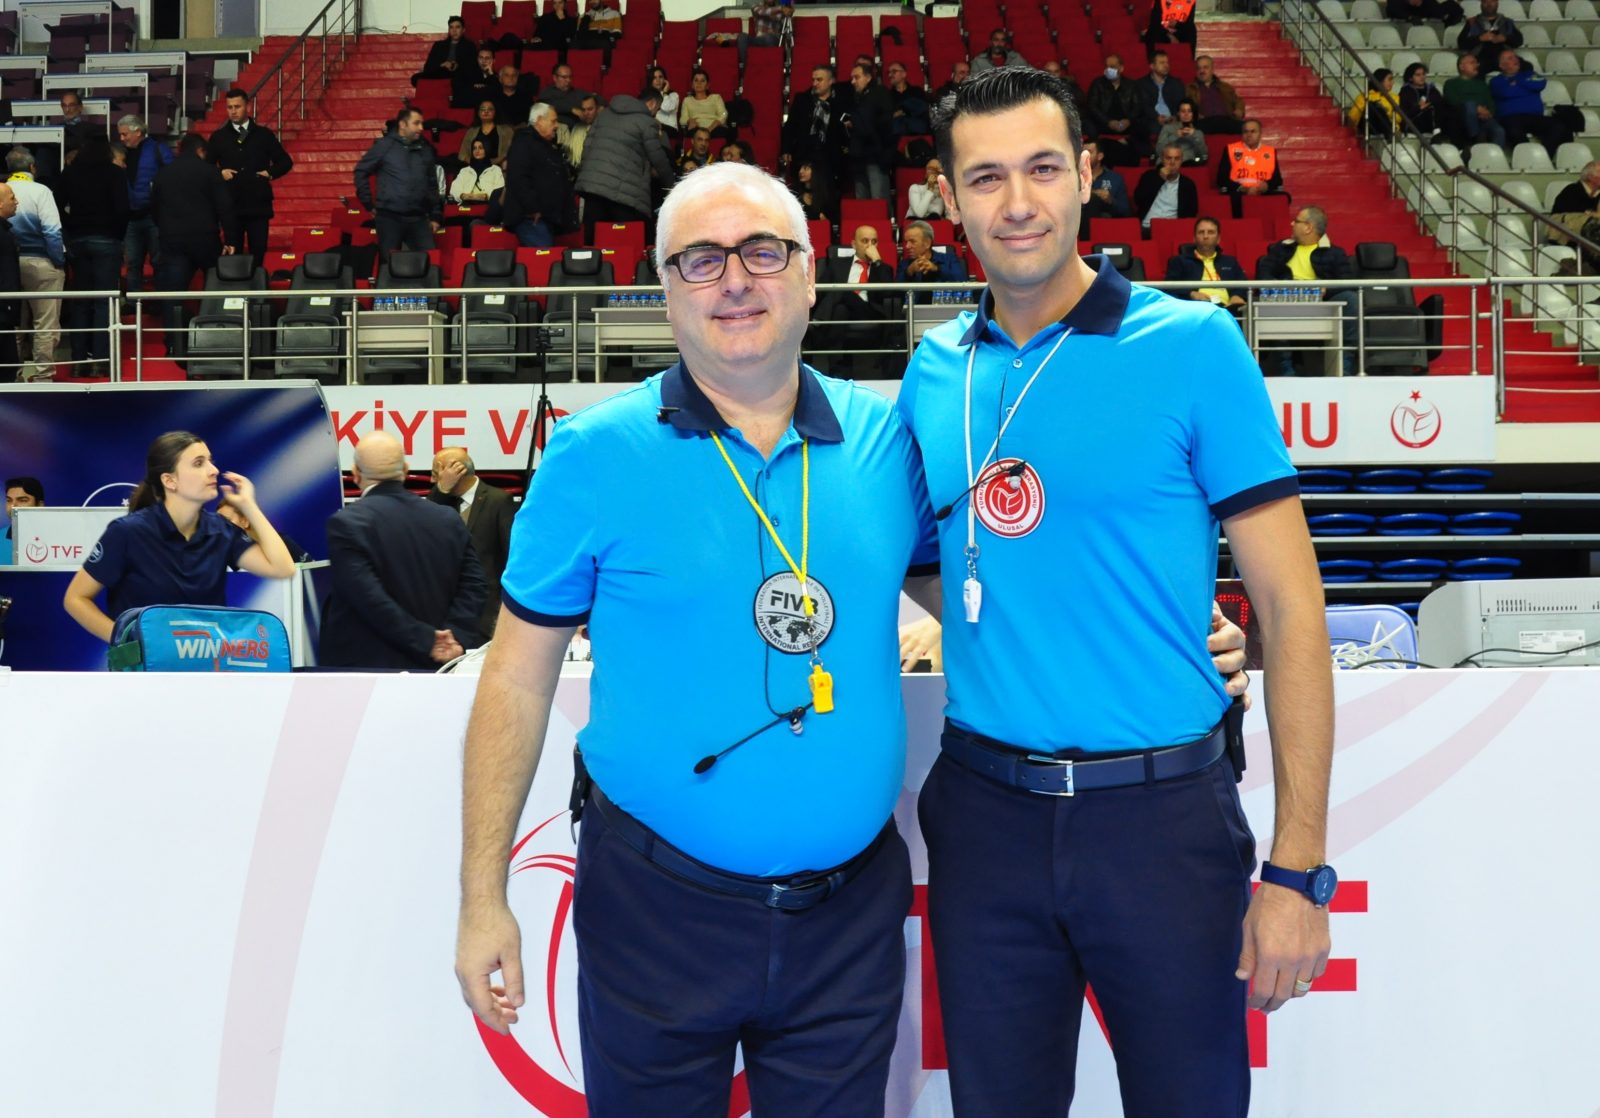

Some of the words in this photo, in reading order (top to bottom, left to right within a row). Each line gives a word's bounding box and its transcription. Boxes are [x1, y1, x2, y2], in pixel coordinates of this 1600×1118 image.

[997, 523, 1024, 531] ULUSAL
[51, 545, 83, 559] TVF
[758, 615, 801, 651] INTERNATIONAL
[175, 638, 269, 660] WINNERS
